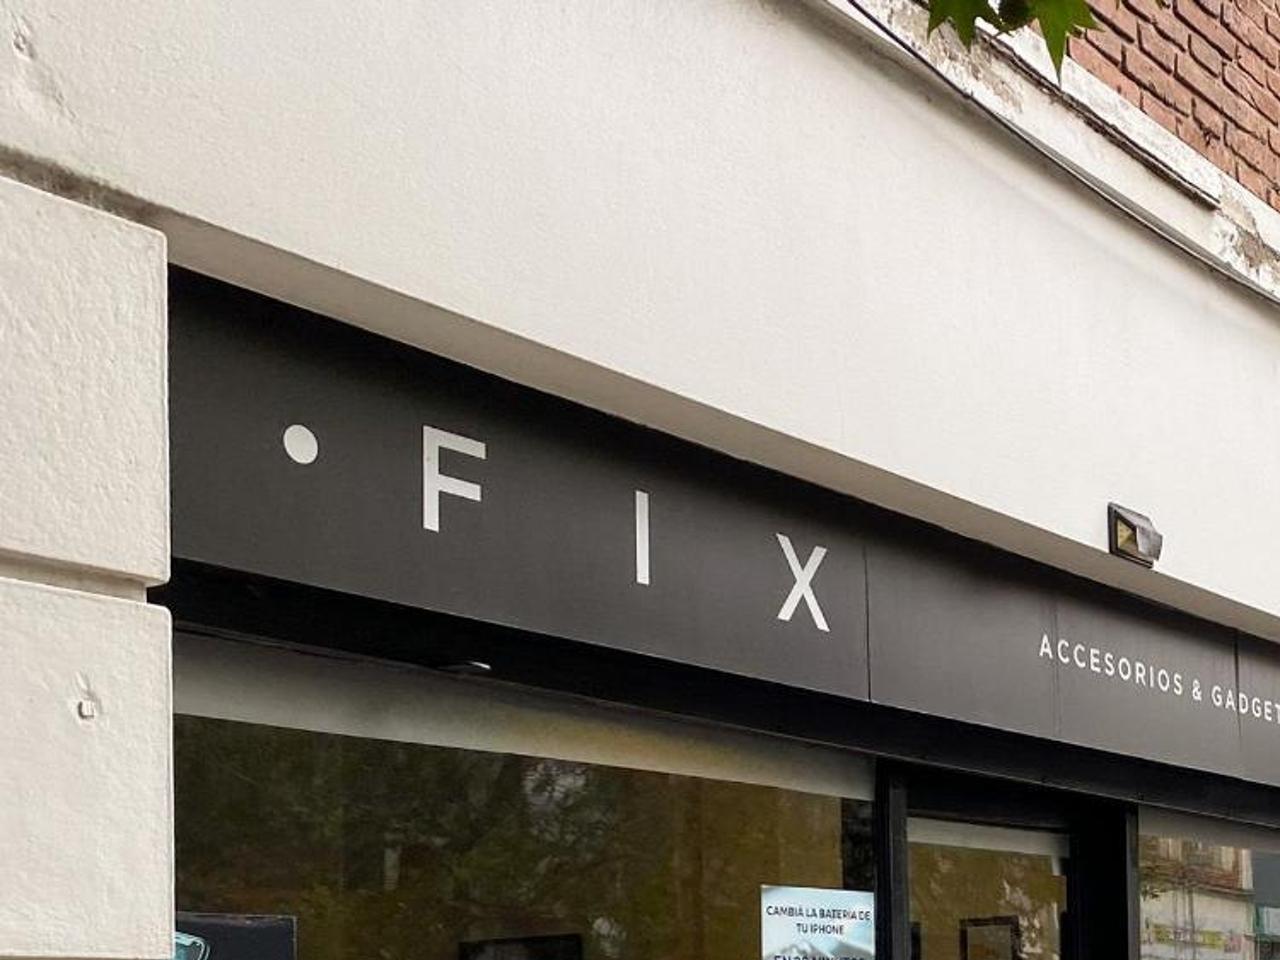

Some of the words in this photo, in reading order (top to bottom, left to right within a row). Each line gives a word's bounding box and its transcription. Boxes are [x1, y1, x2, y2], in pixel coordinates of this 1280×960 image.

[1039, 634, 1183, 695] ACCESORIOS
[1192, 679, 1202, 700] &
[806, 908, 817, 918] LA
[859, 911, 871, 921] DE
[796, 923, 808, 934] TU
[810, 924, 844, 935] IPHONE
